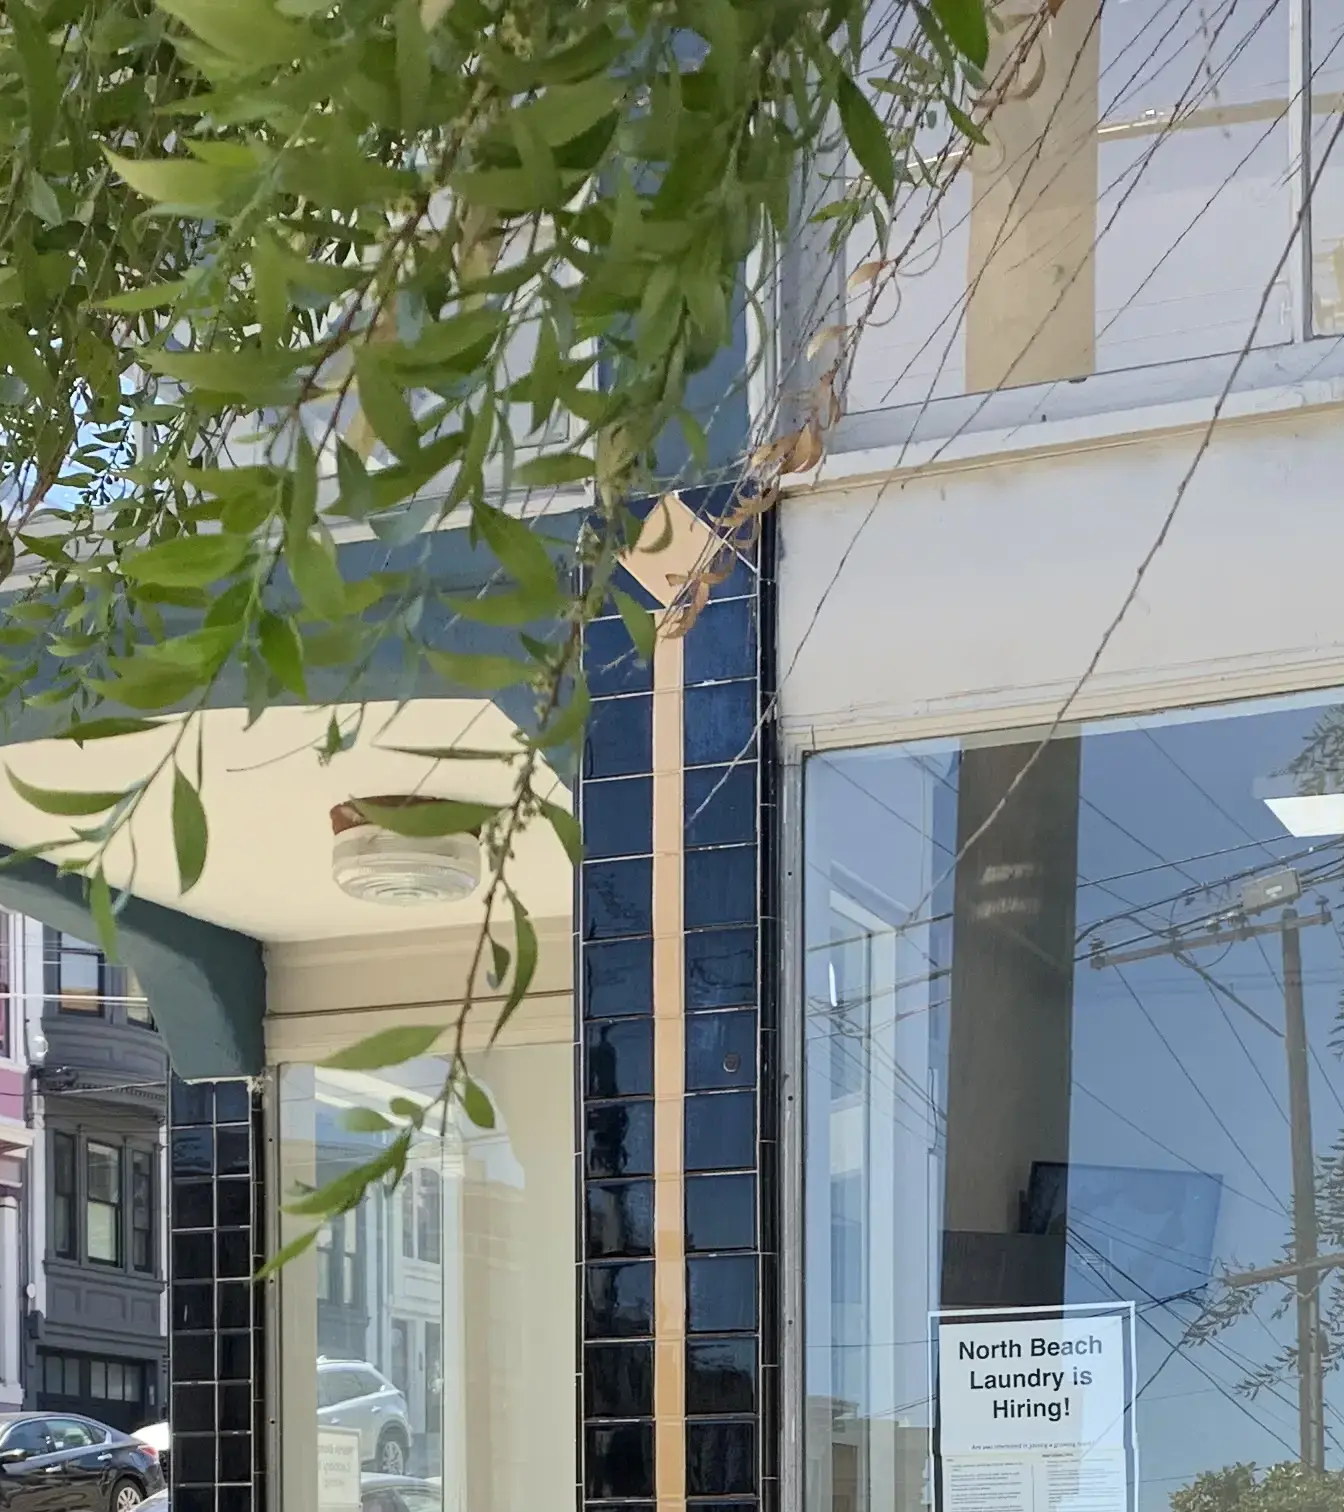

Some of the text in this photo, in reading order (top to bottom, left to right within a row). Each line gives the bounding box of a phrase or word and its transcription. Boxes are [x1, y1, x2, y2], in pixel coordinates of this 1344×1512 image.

[958, 1335, 1103, 1361] North Beach
[969, 1367, 1093, 1392] Laundry is
[992, 1397, 1071, 1422] Hiring!
